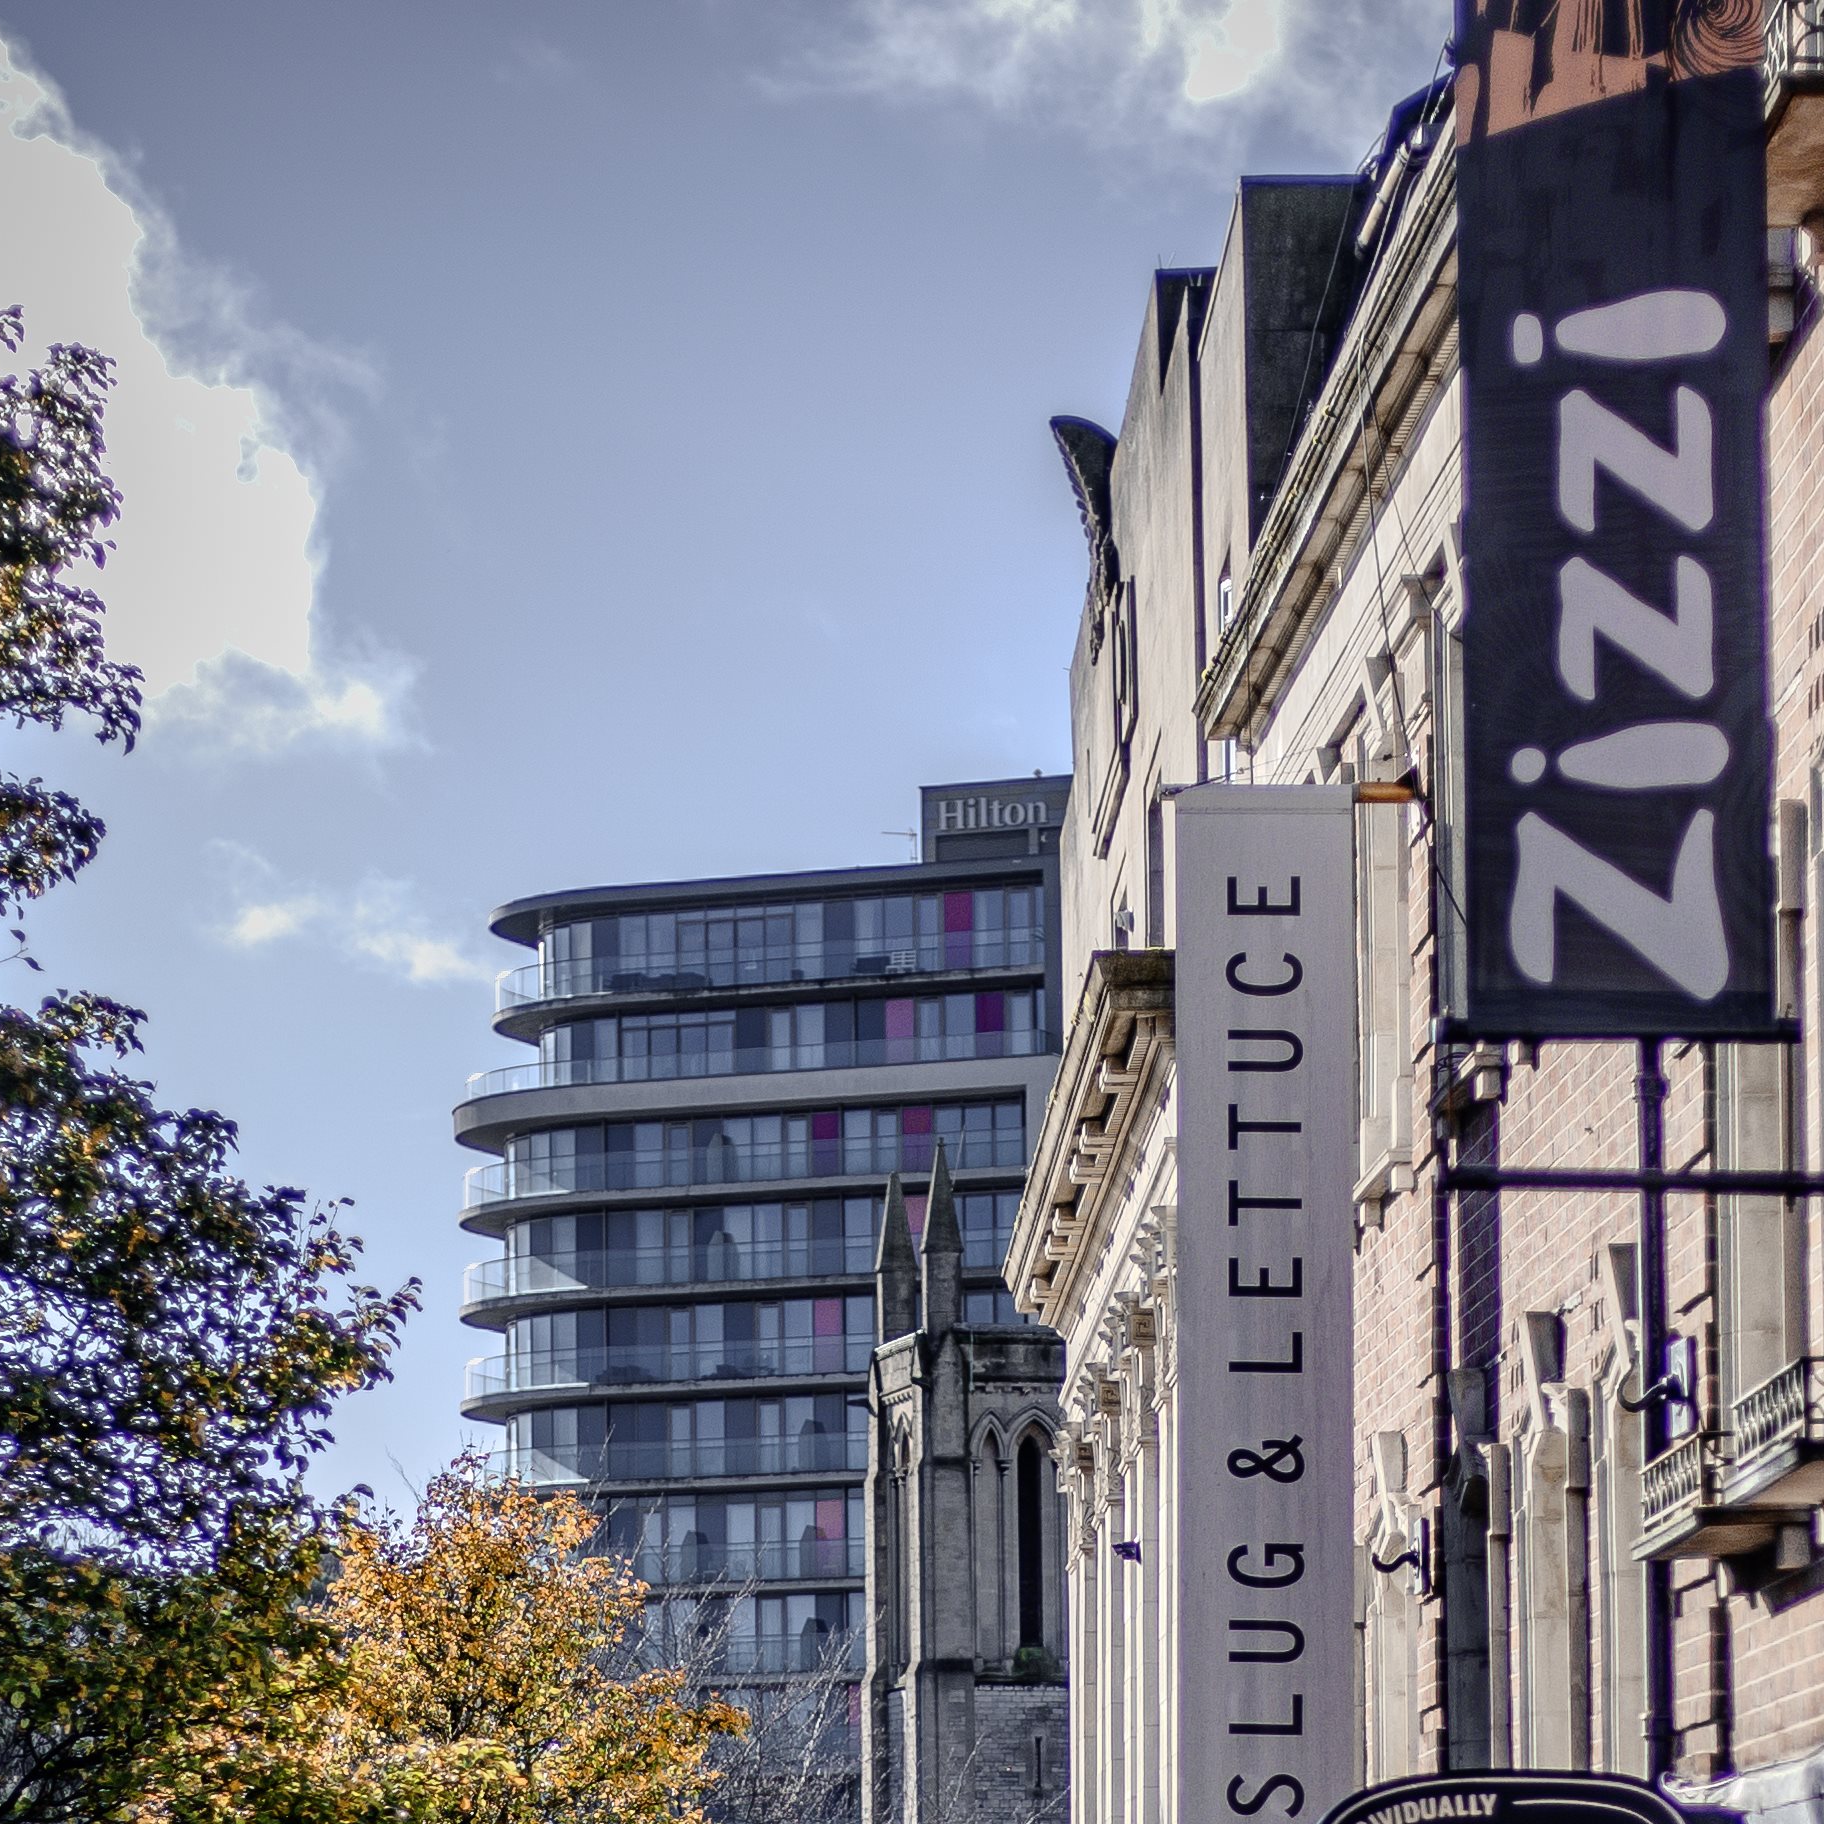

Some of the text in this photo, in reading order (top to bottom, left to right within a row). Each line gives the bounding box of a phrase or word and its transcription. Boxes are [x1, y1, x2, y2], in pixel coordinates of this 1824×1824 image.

[1510, 289, 1730, 1000] Zizzi
[1226, 874, 1306, 1819] SLUG & LETTUCE
